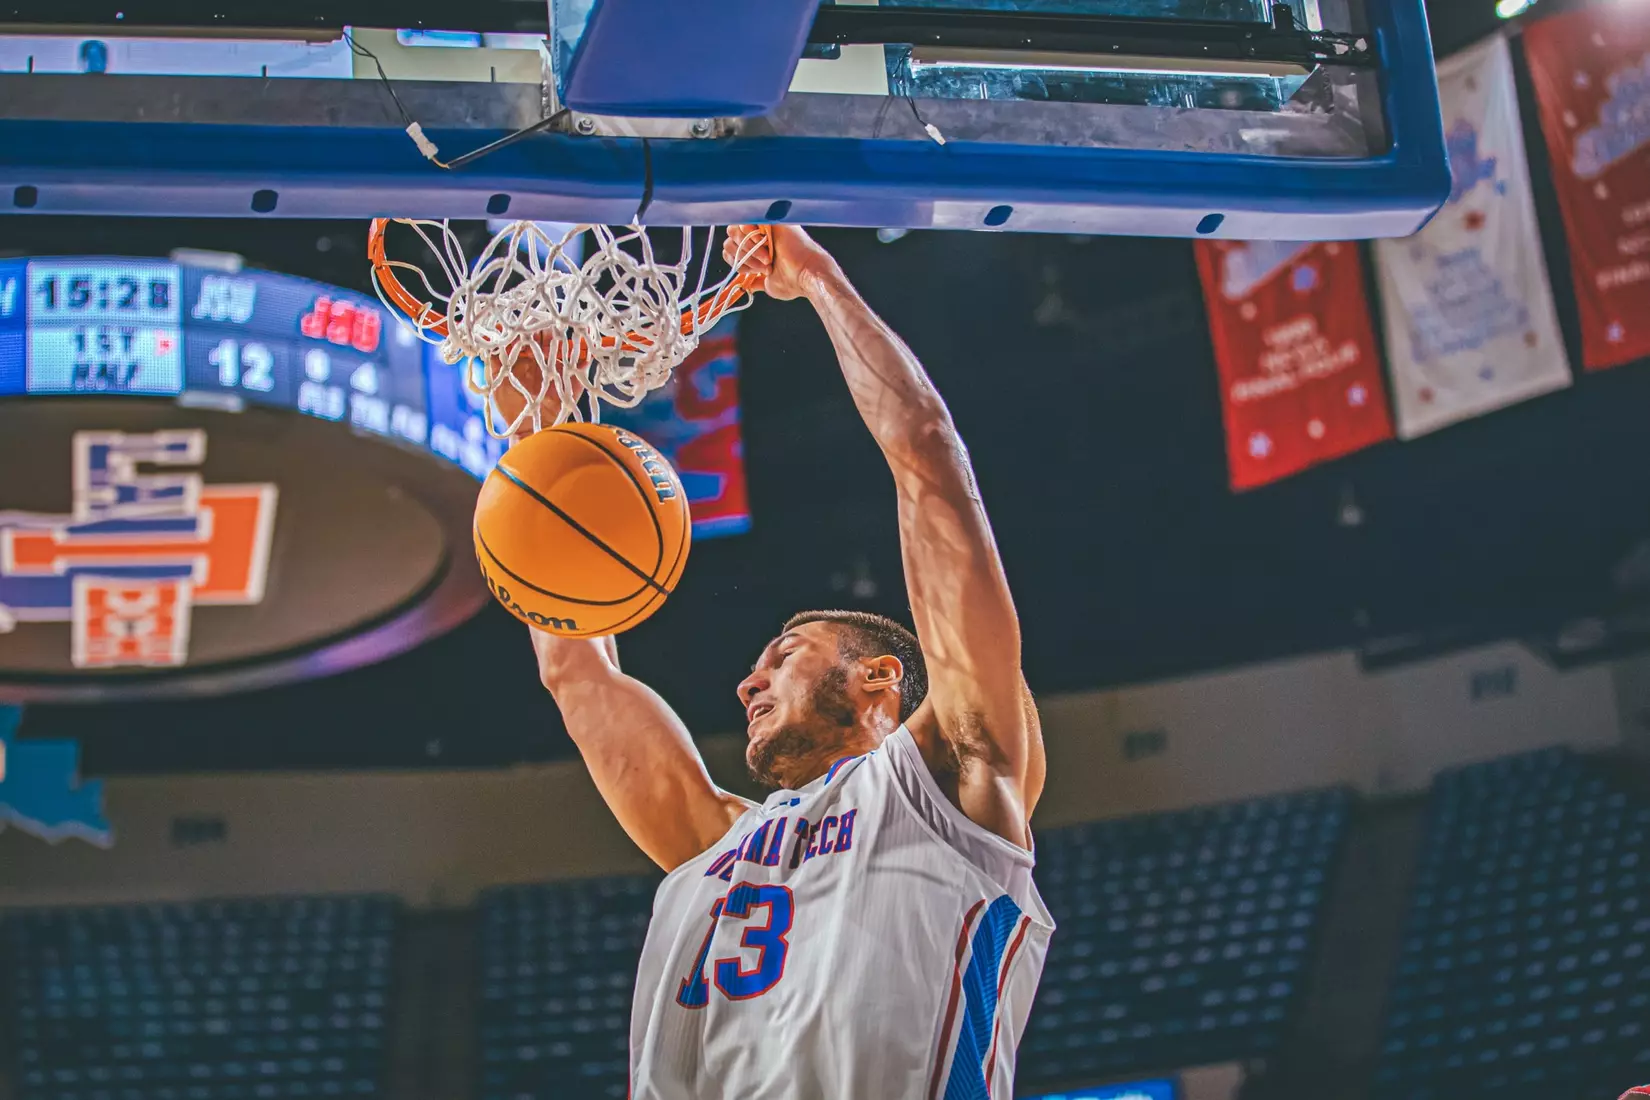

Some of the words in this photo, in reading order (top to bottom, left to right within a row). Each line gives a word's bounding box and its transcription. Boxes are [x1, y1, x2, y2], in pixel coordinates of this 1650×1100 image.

[37, 276, 171, 309] 15:28
[208, 339, 275, 392] 12
[789, 808, 858, 870] TECH
[676, 881, 795, 1010] 13
